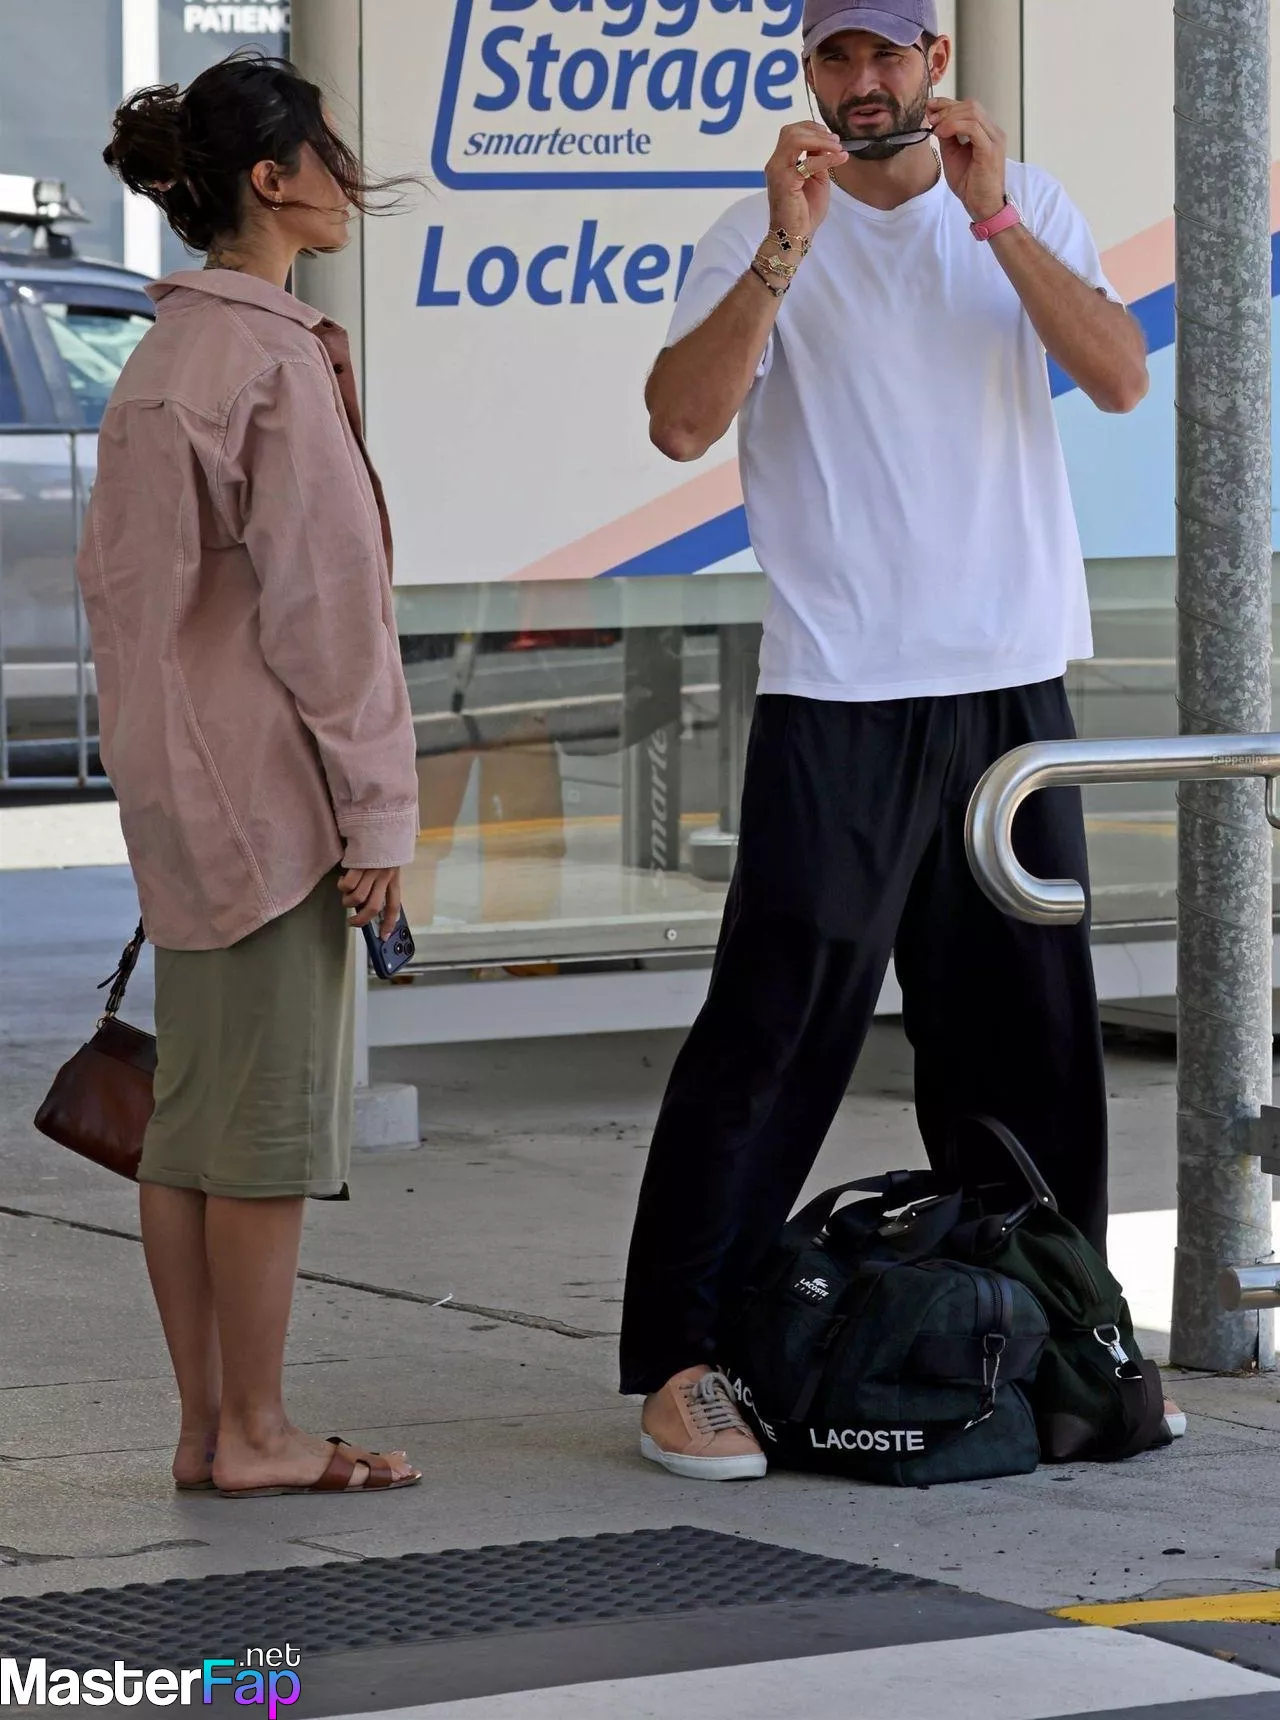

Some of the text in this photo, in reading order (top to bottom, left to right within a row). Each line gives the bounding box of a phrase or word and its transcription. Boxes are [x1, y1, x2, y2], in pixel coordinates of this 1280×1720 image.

[473, 25, 800, 135] Storage
[463, 127, 652, 156] smartecarte
[809, 1428, 925, 1451] LACOSTE
